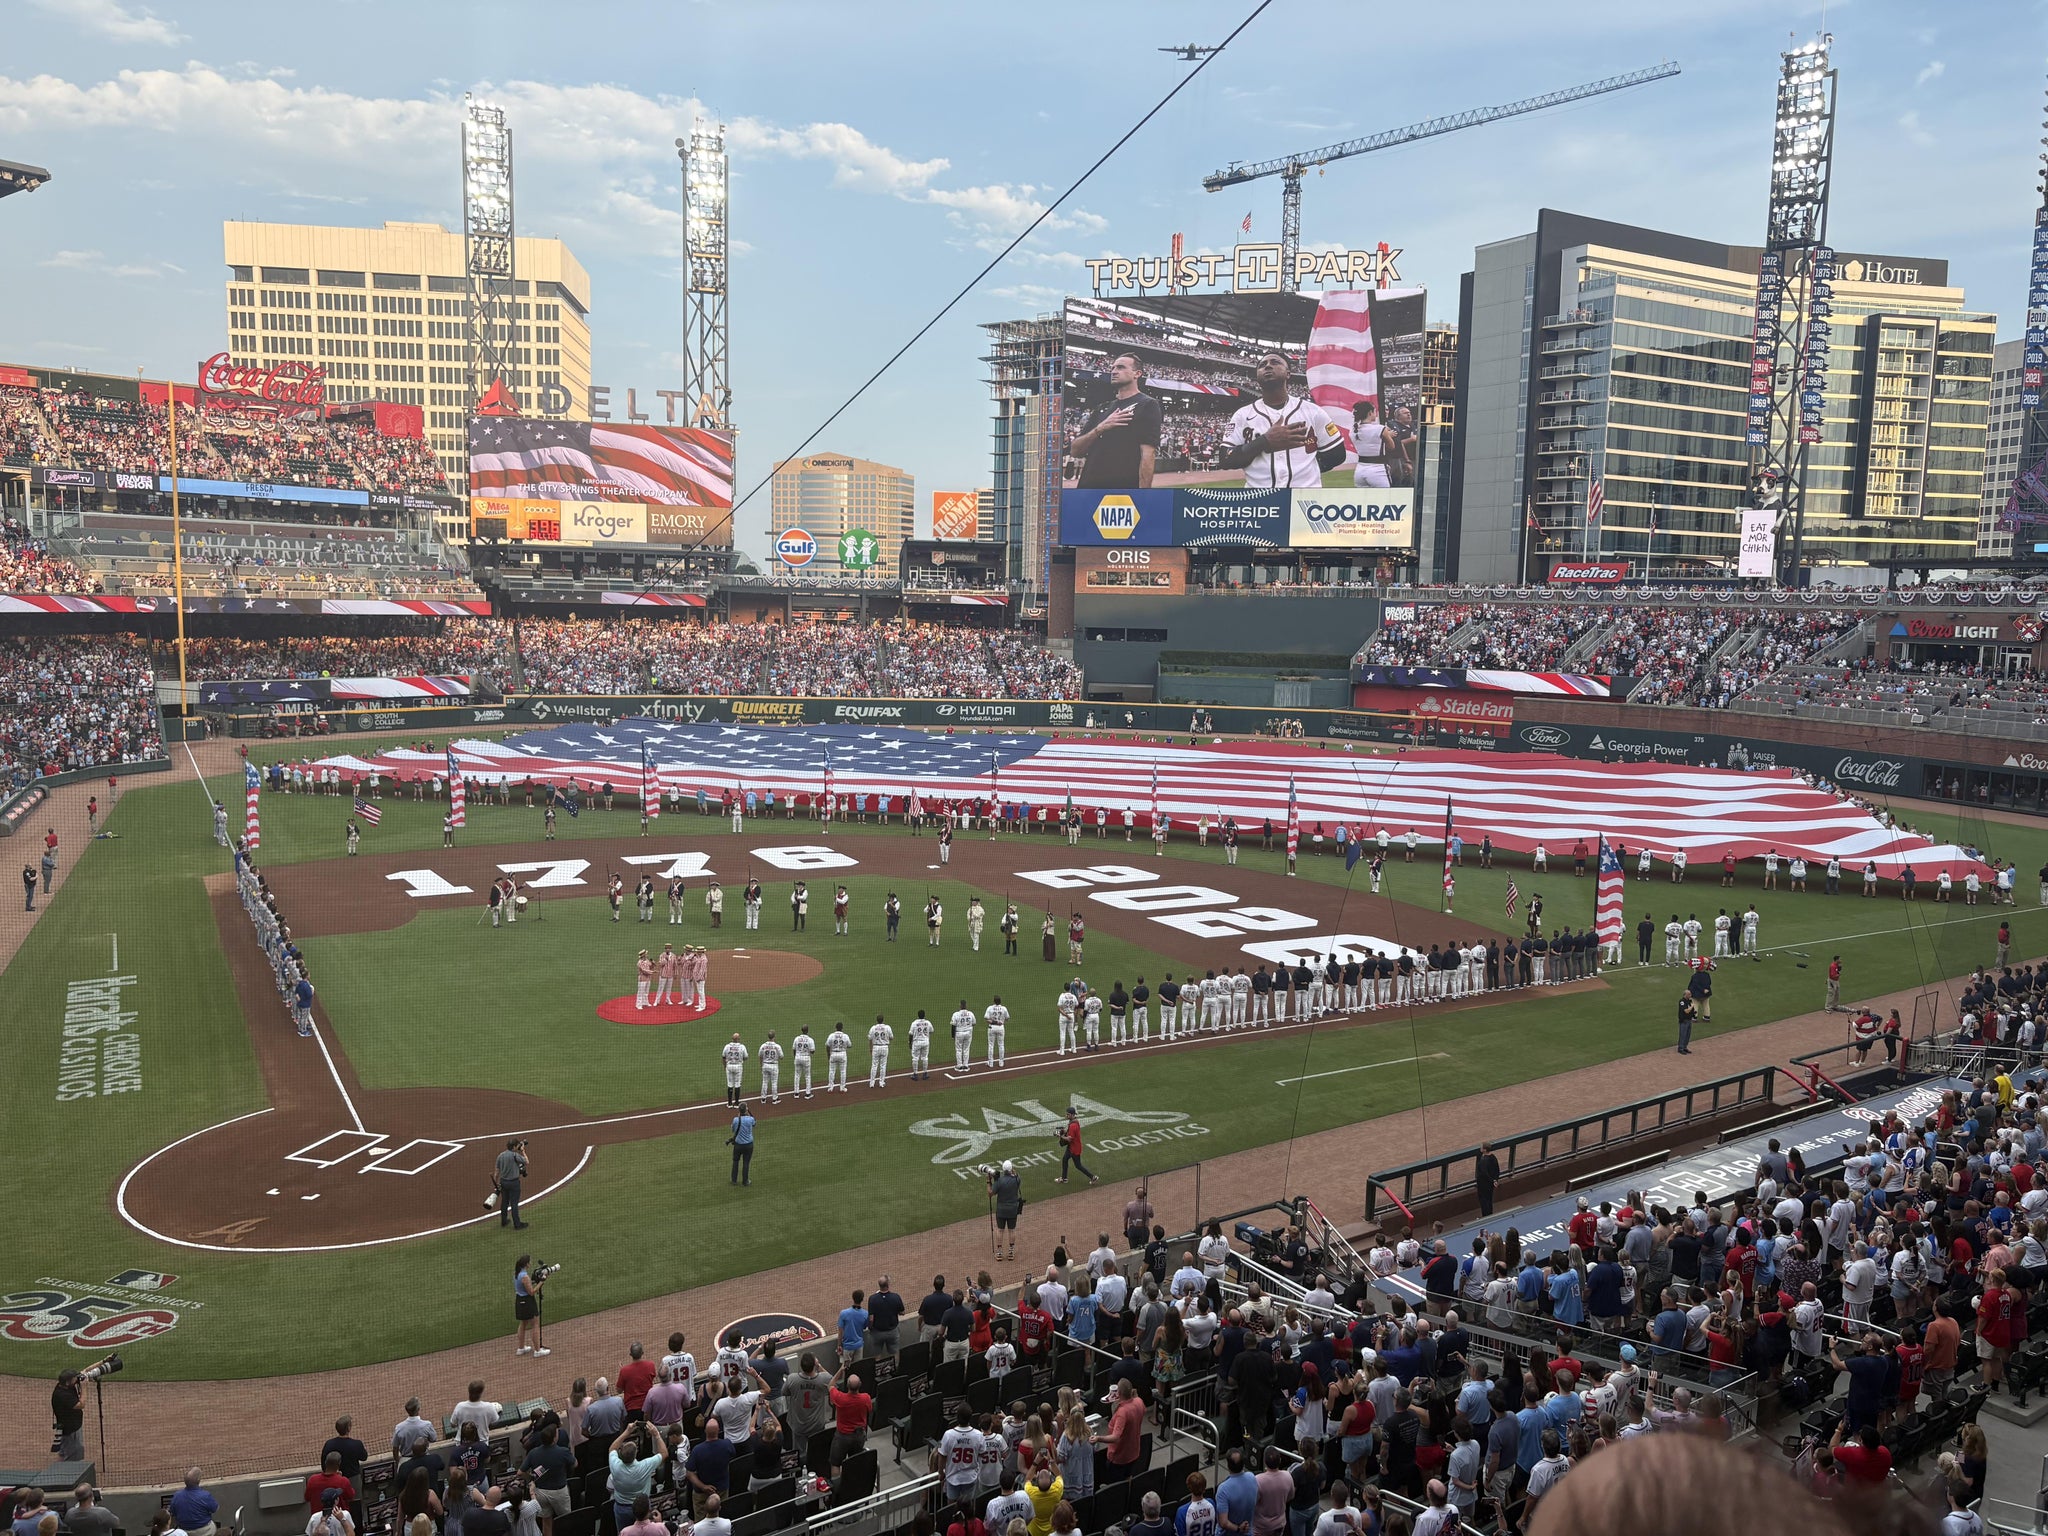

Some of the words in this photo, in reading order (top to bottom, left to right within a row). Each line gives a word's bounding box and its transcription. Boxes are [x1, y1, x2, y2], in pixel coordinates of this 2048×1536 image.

[2038, 231, 2048, 242] 199
[1816, 249, 1832, 260] 1873
[2036, 251, 2048, 262] 200
[1762, 255, 1777, 266] 1872
[1086, 254, 1224, 289] TRUIST
[1294, 248, 1404, 285] PARK
[1815, 267, 1830, 278] 1875
[1865, 260, 1922, 285] HOTEL
[1761, 273, 1776, 284] 1874
[1813, 285, 1829, 296] 1878
[1759, 291, 1775, 302] 1877
[1758, 309, 1774, 319] 1883
[1811, 303, 1827, 314] 1891
[2031, 312, 2047, 323] 2010
[1757, 327, 1772, 337] 1892
[1811, 322, 1826, 332] 1893
[2029, 332, 2045, 343] 2013
[1755, 345, 1770, 355] 1897
[1809, 339, 1825, 350] 1898
[1808, 357, 1823, 368] 1948
[2027, 353, 2043, 364] 2019
[1754, 362, 1769, 372] 1914
[199, 352, 329, 406] Coca-Cola
[1806, 375, 1822, 386] 1958
[2025, 372, 2040, 383] 2021
[1753, 380, 1767, 390] 1957
[1751, 398, 1766, 408] 1969
[1804, 393, 1820, 404] 1982
[2023, 394, 2039, 405] 2023
[542, 384, 722, 425] DELTA
[1749, 415, 1764, 425] 1991
[1803, 411, 1818, 421] 1992
[1748, 433, 1763, 443] 1993
[1801, 429, 1817, 440] 1995
[116, 473, 153, 483] BRAVES
[117, 481, 153, 493] VISION
[245, 483, 274, 493] FRESCA
[518, 483, 537, 492] THE
[538, 484, 558, 493] CITY
[560, 486, 599, 495] SPRINGS
[601, 487, 641, 496] THEATER
[643, 489, 689, 499] COMPANY
[372, 495, 388, 504] 7:58
[389, 496, 401, 505] PM
[937, 496, 956, 514] THE
[487, 501, 510, 511] MEGA
[934, 492, 978, 538] HOME
[1100, 506, 1133, 528] NAPA
[1183, 506, 1279, 518] NORTHSIDE
[1306, 503, 1407, 523] COOLRAY
[530, 520, 560, 533] 396
[574, 504, 634, 538] Kroger
[651, 513, 708, 529] EMORY
[950, 511, 978, 538] DEPOT
[1200, 520, 1261, 530] HOSPITAL
[1333, 522, 1356, 530] Cooling
[1361, 522, 1385, 530] Heating
[651, 527, 705, 537] HEALTHCARE
[1339, 528, 1366, 536] Plumbing
[1750, 522, 1768, 533] EAT
[1748, 532, 1768, 543] MOR
[240, 538, 319, 561] AARON
[316, 542, 416, 565] TERRACE
[777, 540, 815, 554] Gulf
[1742, 542, 1773, 554] CHIKIN
[1106, 550, 1151, 564] ORIS
[1554, 566, 1618, 580] RaceTrac
[1385, 606, 1415, 615] BRAVES
[1386, 613, 1414, 621] VISION
[1908, 618, 1954, 638] Coors
[1955, 626, 1999, 640] LIGHT
[554, 704, 611, 717] Wellstar
[641, 702, 705, 720] xfinity
[732, 701, 803, 715] QUIKRETE
[835, 705, 902, 719] EQUIFAX
[960, 705, 1015, 716] HYUNDAI
[1050, 703, 1073, 713] PAPA
[1049, 712, 1074, 720] JOHNS
[374, 718, 406, 726] COLLEGE
[1466, 737, 1496, 747] National
[1529, 730, 1562, 745] Ford
[1608, 740, 1651, 756] Georgia
[1654, 743, 1689, 757] Power
[1752, 751, 1776, 763] KAISER
[1834, 755, 1905, 790] Coca-Cola
[385, 845, 860, 898] 1776
[1011, 865, 1420, 968] 2026
[56, 1037, 98, 1102] CASINOS
[102, 1033, 143, 1096] CHEROKEE
[908, 1092, 1190, 1164] SAIA
[1085, 1122, 1211, 1154] LOGISTICS
[1815, 1133, 1837, 1147] OF
[1830, 1127, 1864, 1143] THE
[952, 1150, 1062, 1181] FRGHT
[35, 1277, 128, 1299] CELEBRATING
[126, 1291, 205, 1310] AMERICA'S
[1079, 1305, 1091, 1317] 74
[0, 1290, 180, 1351] 250
[1025, 1320, 1041, 1335] 13
[996, 1357, 1007, 1368] 13
[673, 1366, 690, 1382] 13
[723, 1363, 739, 1377] 13
[957, 1437, 971, 1445] WHITE
[952, 1447, 975, 1464] 36
[981, 1450, 998, 1465] 53
[1001, 1502, 1025, 1518] CONINE
[1191, 1508, 1211, 1521] OLSON
[1190, 1519, 1213, 1536] 28
